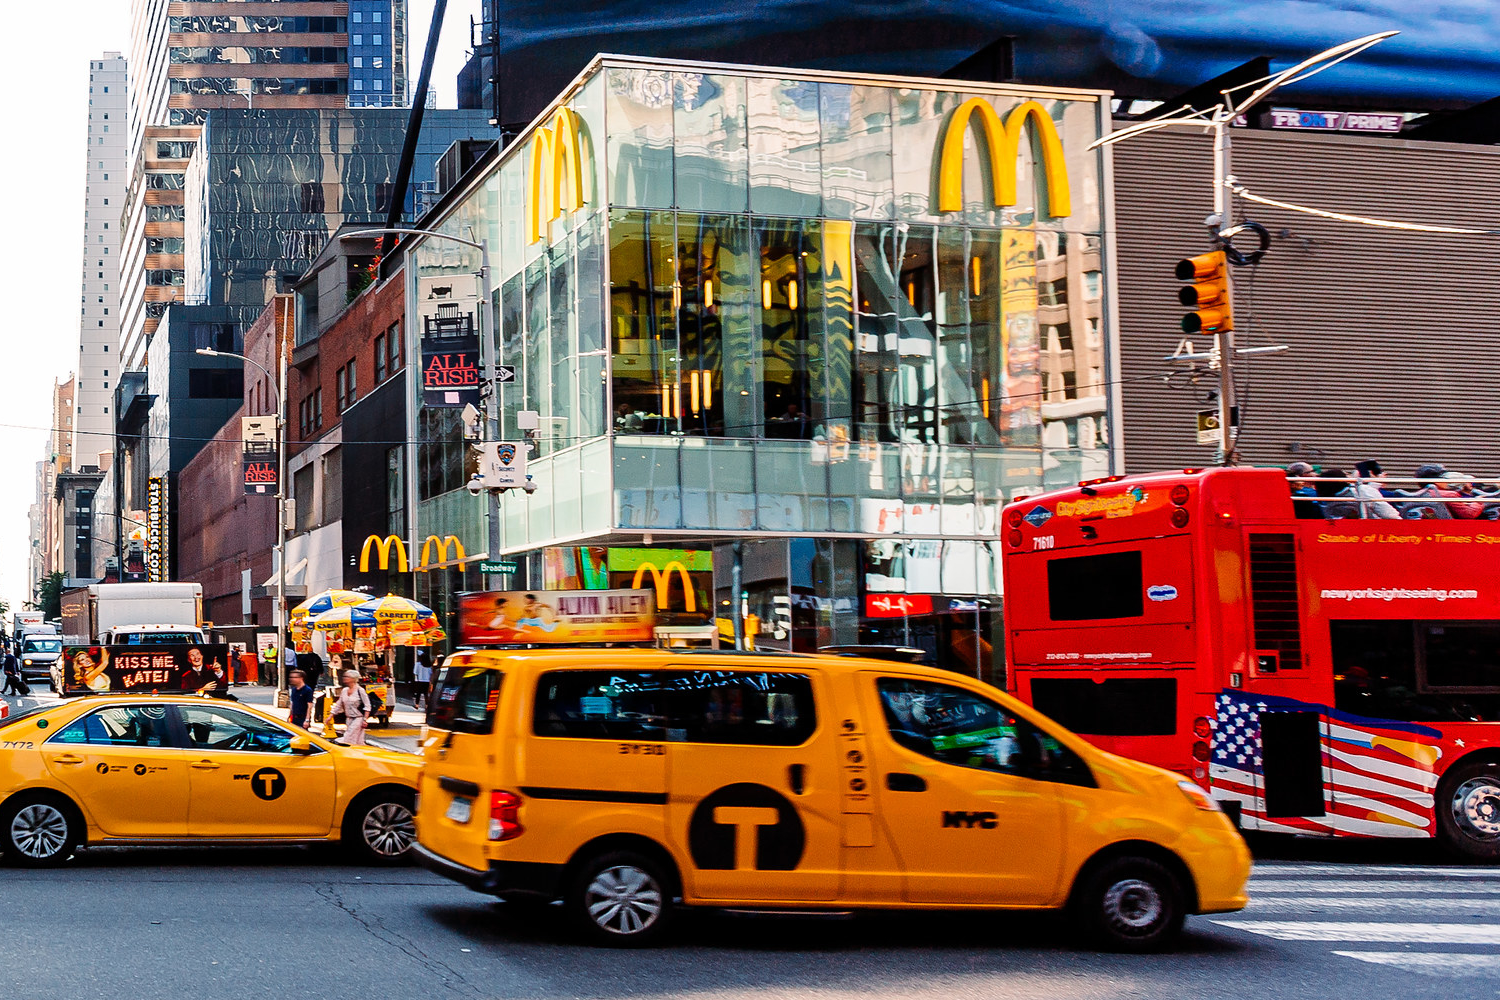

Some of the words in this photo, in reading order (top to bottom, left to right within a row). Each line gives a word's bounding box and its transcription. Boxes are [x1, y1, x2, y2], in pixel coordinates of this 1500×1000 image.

[1273, 111, 1339, 128] FRONT
[1348, 115, 1398, 130] PRIME
[427, 353, 474, 370] ALL
[424, 368, 479, 386] RISE
[247, 463, 274, 473] ALL
[244, 471, 276, 482] RISE
[149, 483, 160, 552] STARBUCKS
[1033, 535, 1055, 550] 71610
[1317, 533, 1360, 544] Statue
[1362, 533, 1375, 543] of
[1379, 533, 1422, 545] Liberty
[1435, 533, 1472, 544] Times
[480, 562, 517, 574] Broadway
[1320, 587, 1478, 602] newyorksightseeing.com
[114, 656, 150, 669] KISS
[152, 656, 180, 671] ME,
[122, 670, 169, 688] KATE!
[3, 740, 35, 750] 7Y72
[941, 810, 999, 829] NYC
